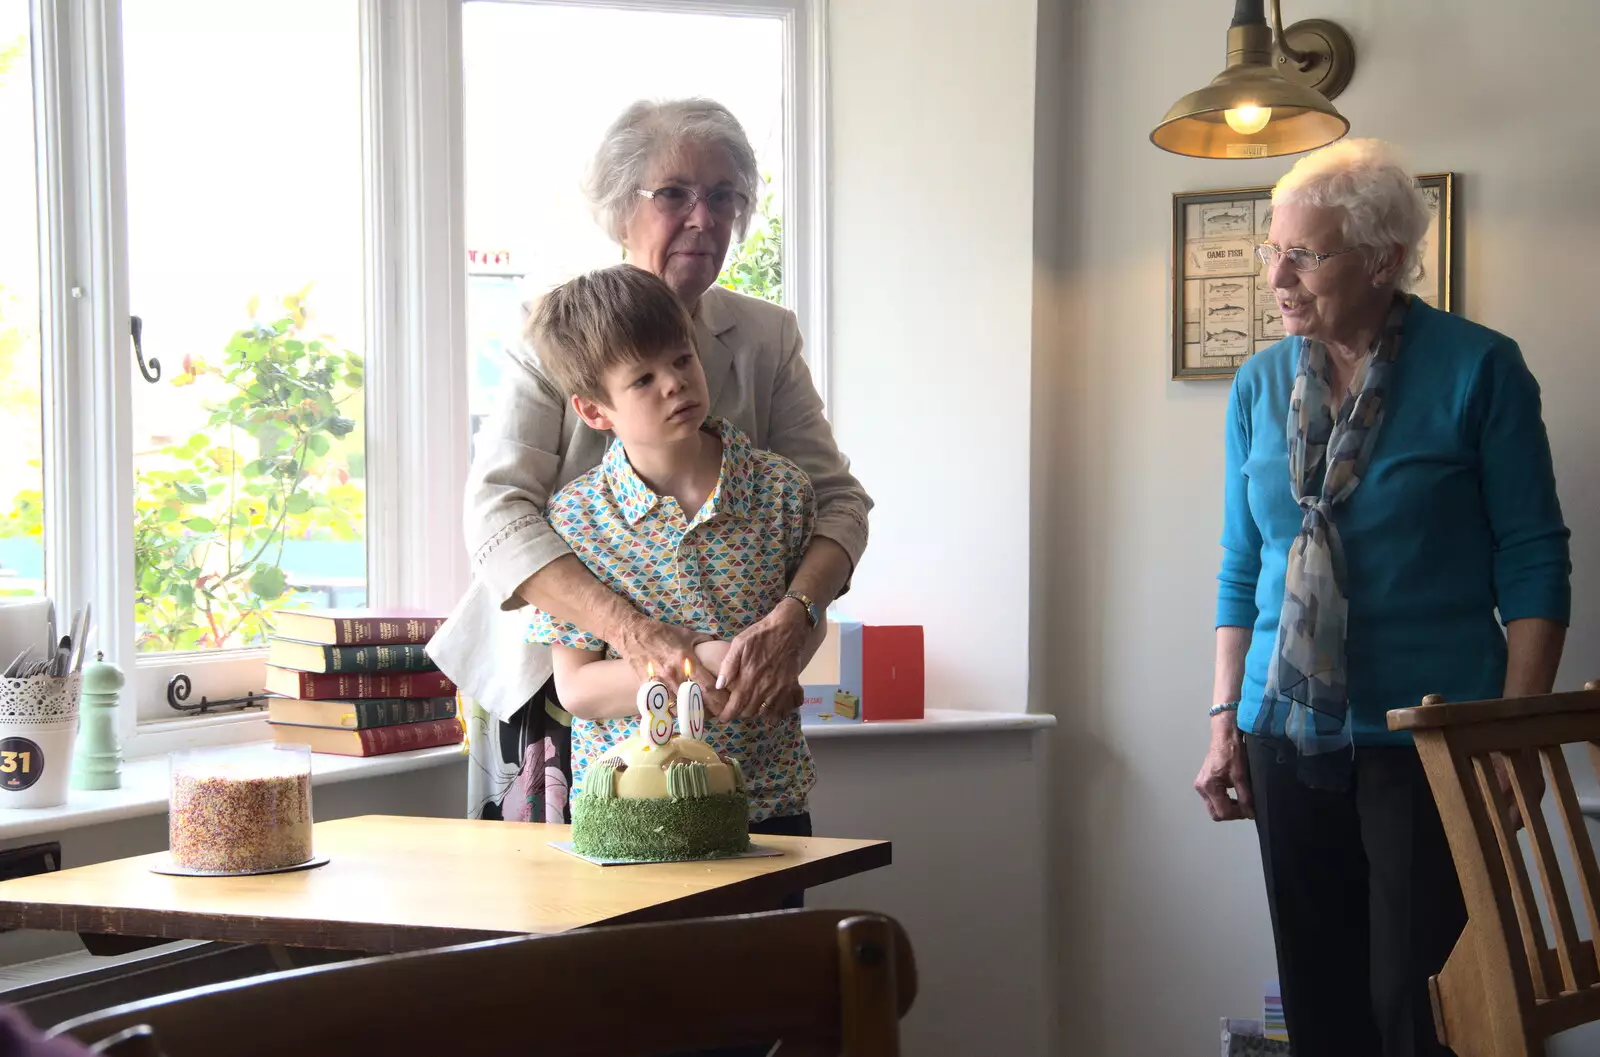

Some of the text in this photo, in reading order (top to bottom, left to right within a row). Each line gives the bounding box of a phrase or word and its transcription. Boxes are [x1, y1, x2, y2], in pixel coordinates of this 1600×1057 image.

[1207, 249, 1243, 259] GAME FISH
[638, 681, 704, 745] 80
[0, 751, 31, 773] 31
